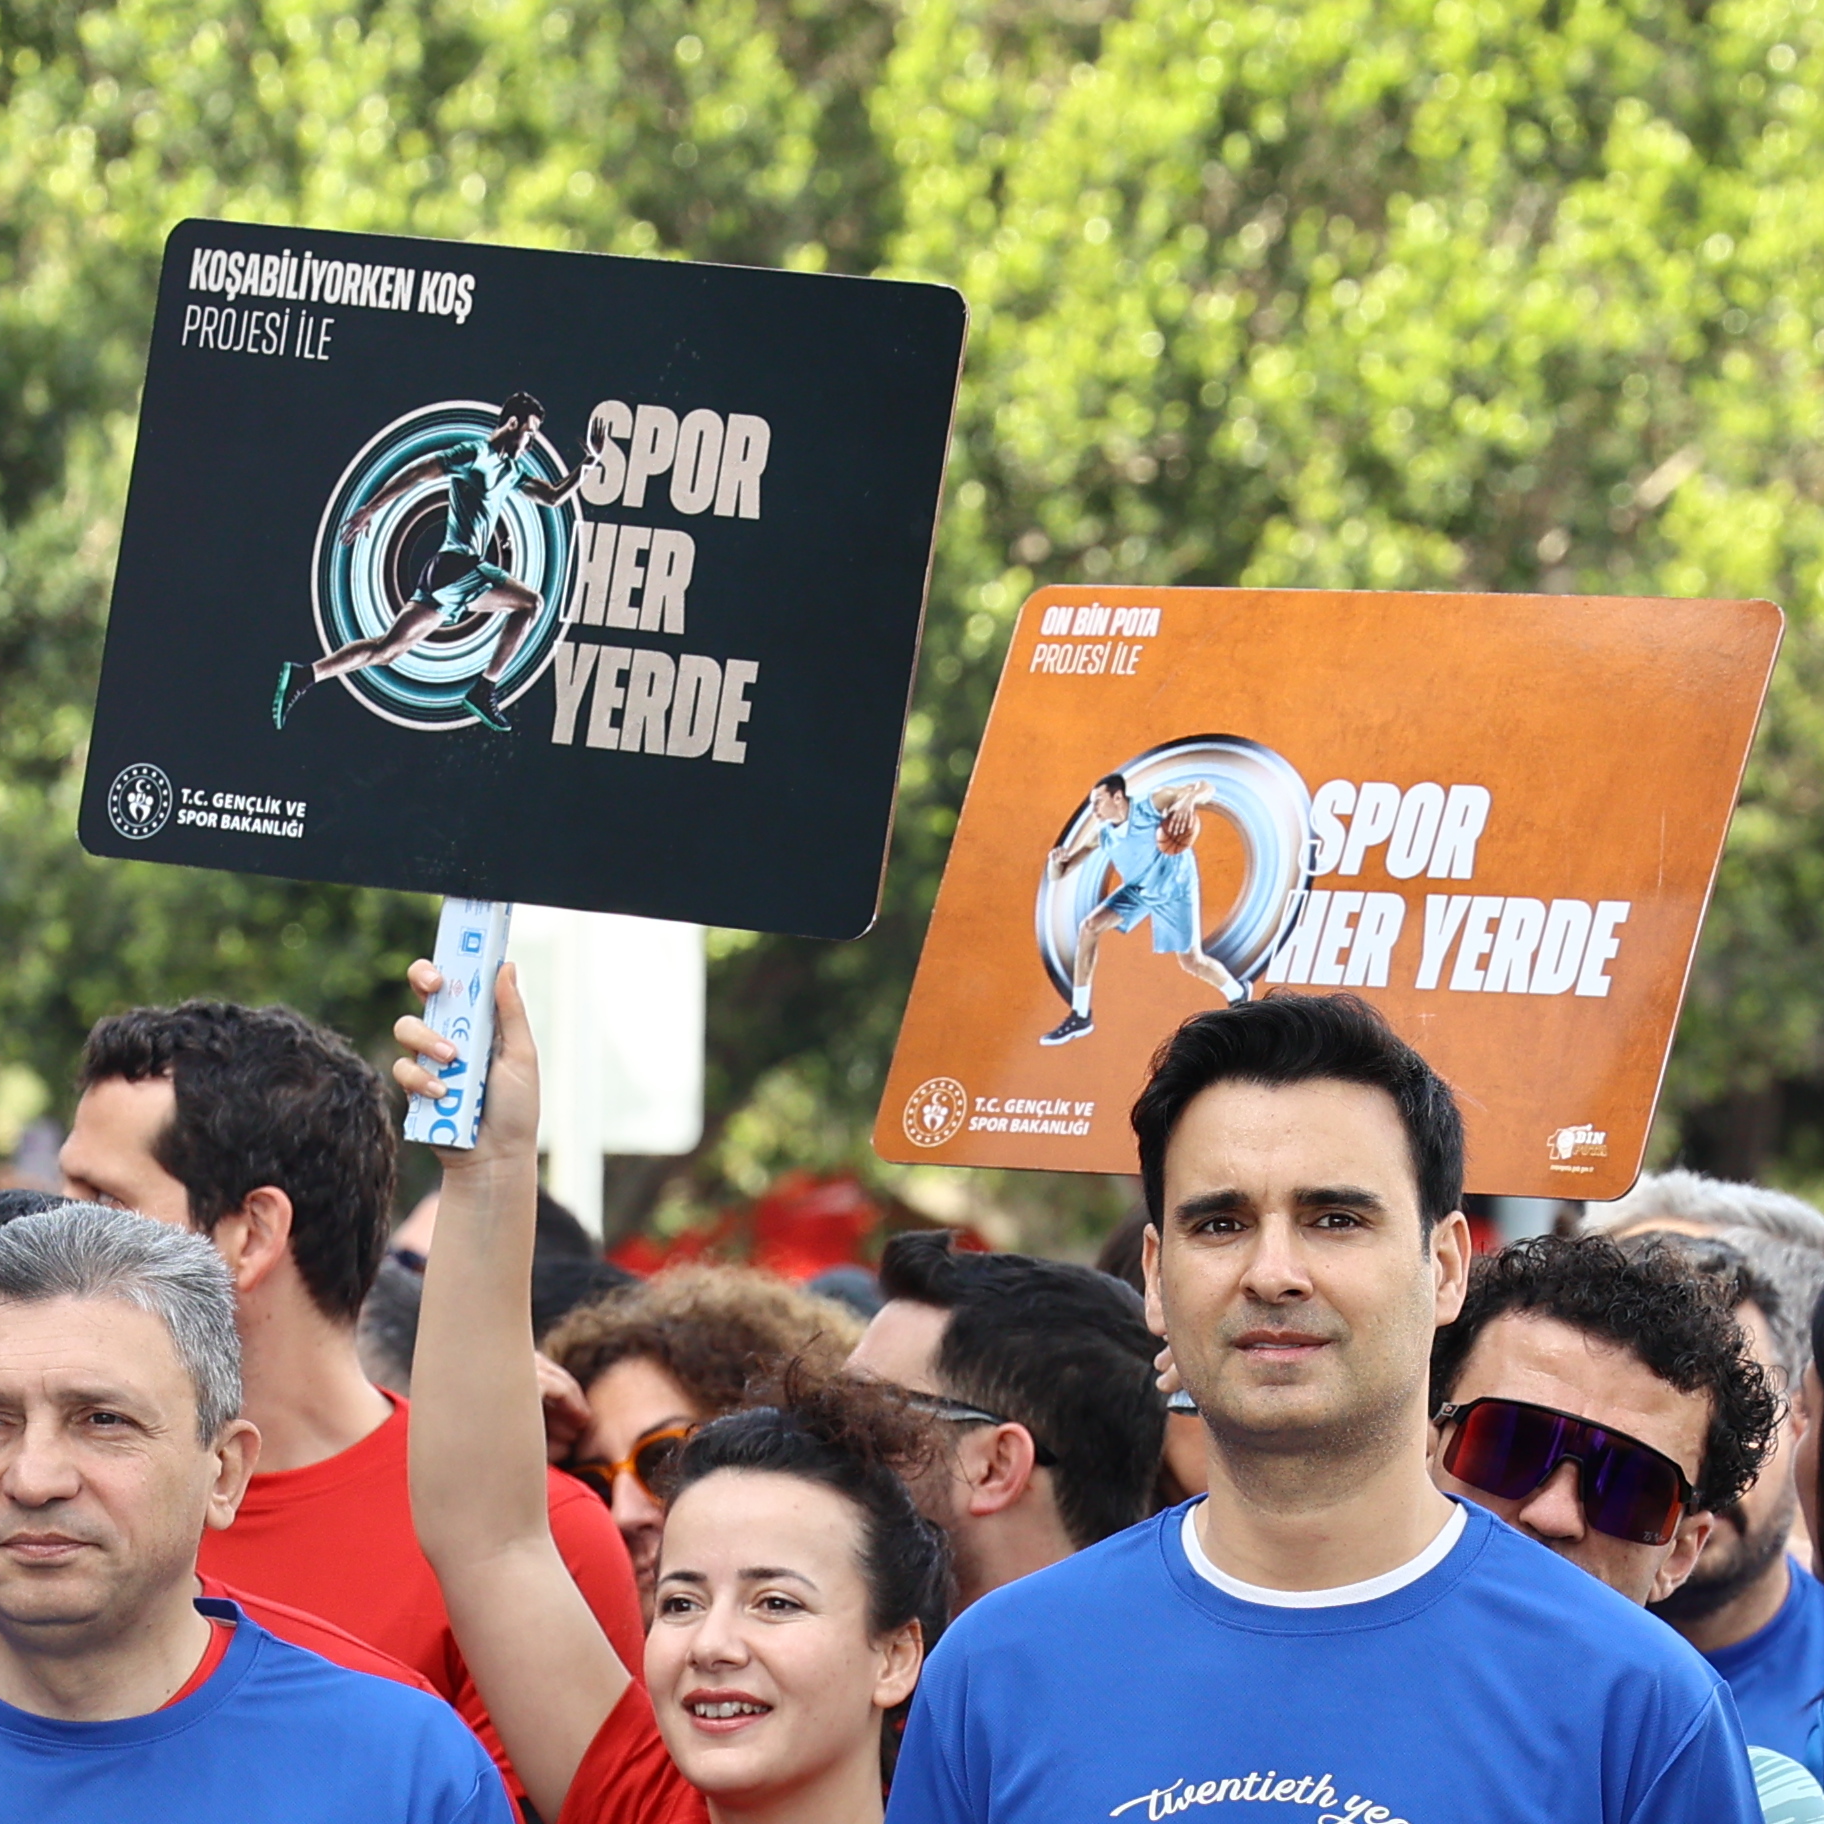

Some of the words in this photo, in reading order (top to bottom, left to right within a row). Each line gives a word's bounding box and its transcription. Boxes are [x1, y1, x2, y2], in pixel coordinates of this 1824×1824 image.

[189, 248, 415, 311] KOŞABİLİYORKEN
[417, 270, 475, 324] KOŞ
[182, 304, 290, 356] PROJESİ
[295, 309, 335, 360] İLE
[583, 400, 772, 520] SPOR
[561, 520, 695, 635] HER
[1040, 606, 1075, 636] ON
[1072, 602, 1112, 636] BİN
[1109, 607, 1162, 637] POTA
[1029, 641, 1112, 675] PROJESİ
[1110, 641, 1143, 675] İLE
[550, 641, 760, 765] YERDE
[176, 809, 218, 829] SPOR
[220, 813, 305, 838] BAKANLIĞI
[181, 788, 208, 807] T.C.
[212, 792, 282, 816] GENÇLİK
[285, 801, 307, 818] VE
[1299, 777, 1491, 881] SPOR
[1266, 888, 1406, 988] HER
[1416, 894, 1630, 998] YERDE
[968, 1116, 1009, 1132] SPOR
[1009, 1118, 1090, 1136] BAKANLIĞI
[974, 1097, 1000, 1113] T.C.
[1004, 1098, 1071, 1118] GENÇLİK
[1074, 1101, 1095, 1117] VE
